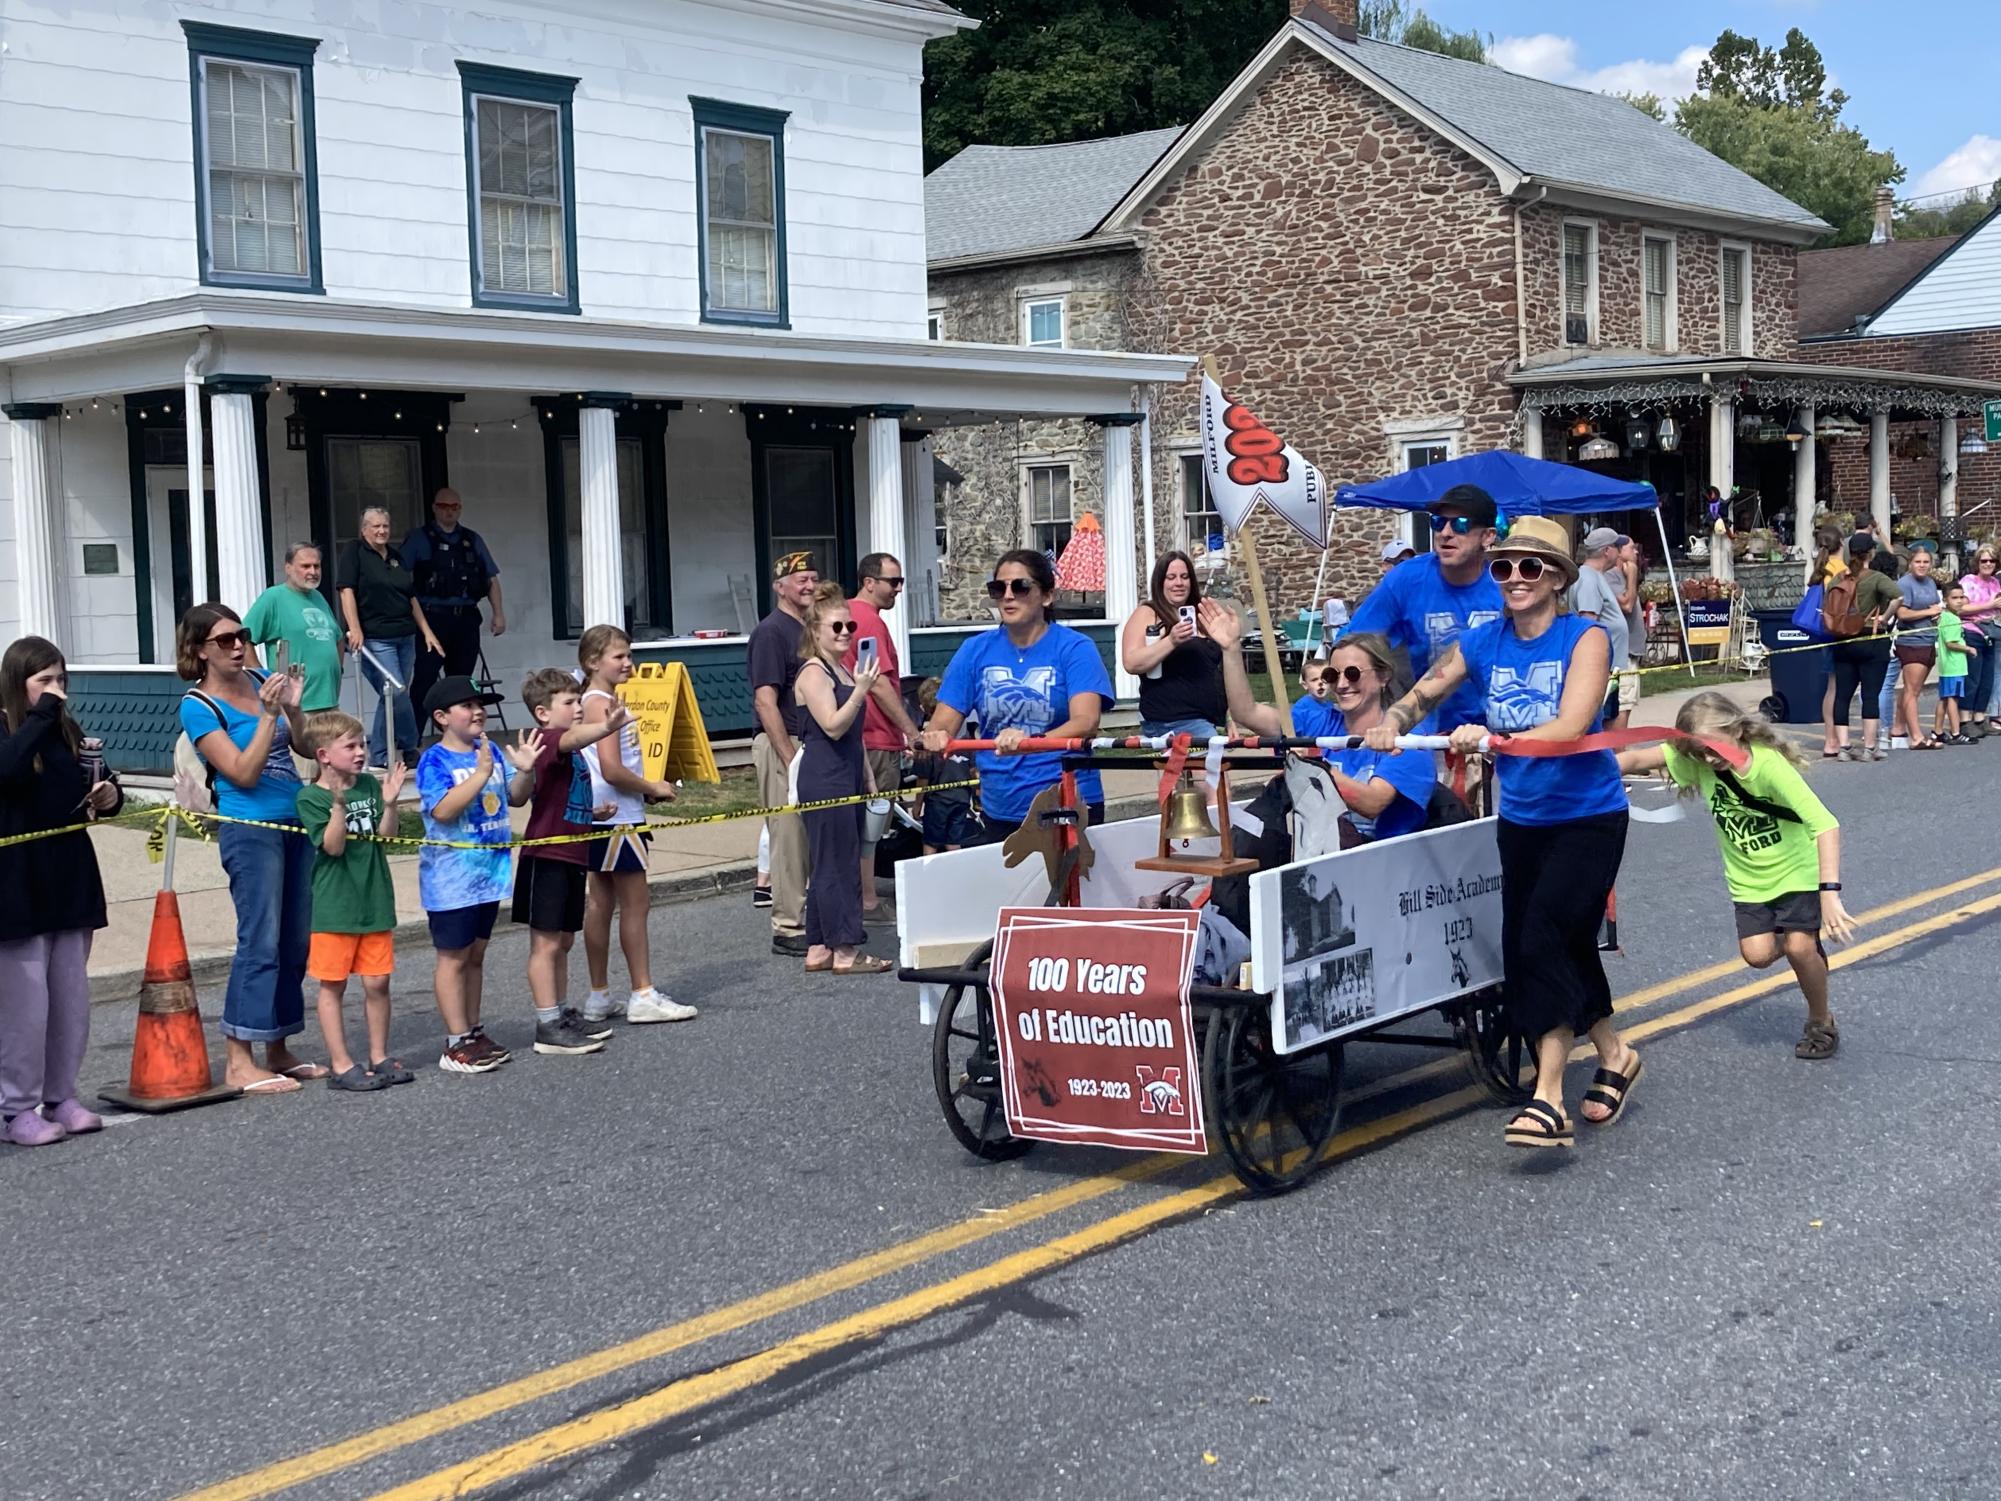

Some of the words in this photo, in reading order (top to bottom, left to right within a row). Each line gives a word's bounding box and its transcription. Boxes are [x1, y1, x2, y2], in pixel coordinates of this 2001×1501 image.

[1204, 394, 1219, 474] MILFORD
[1689, 612, 1729, 623] STROCHAK
[646, 700, 670, 714] County
[640, 720, 661, 735] Office
[648, 742, 663, 758] ID
[1399, 889, 1422, 917] Hill
[1424, 884, 1454, 909] Side
[1456, 873, 1503, 902] Academ
[1444, 916, 1473, 945] 1923
[1027, 957, 1069, 992] 100
[1076, 957, 1147, 995] Years
[1018, 1008, 1042, 1041] of
[1045, 1008, 1174, 1048] Education
[1067, 1078, 1132, 1099] 1923-2023
